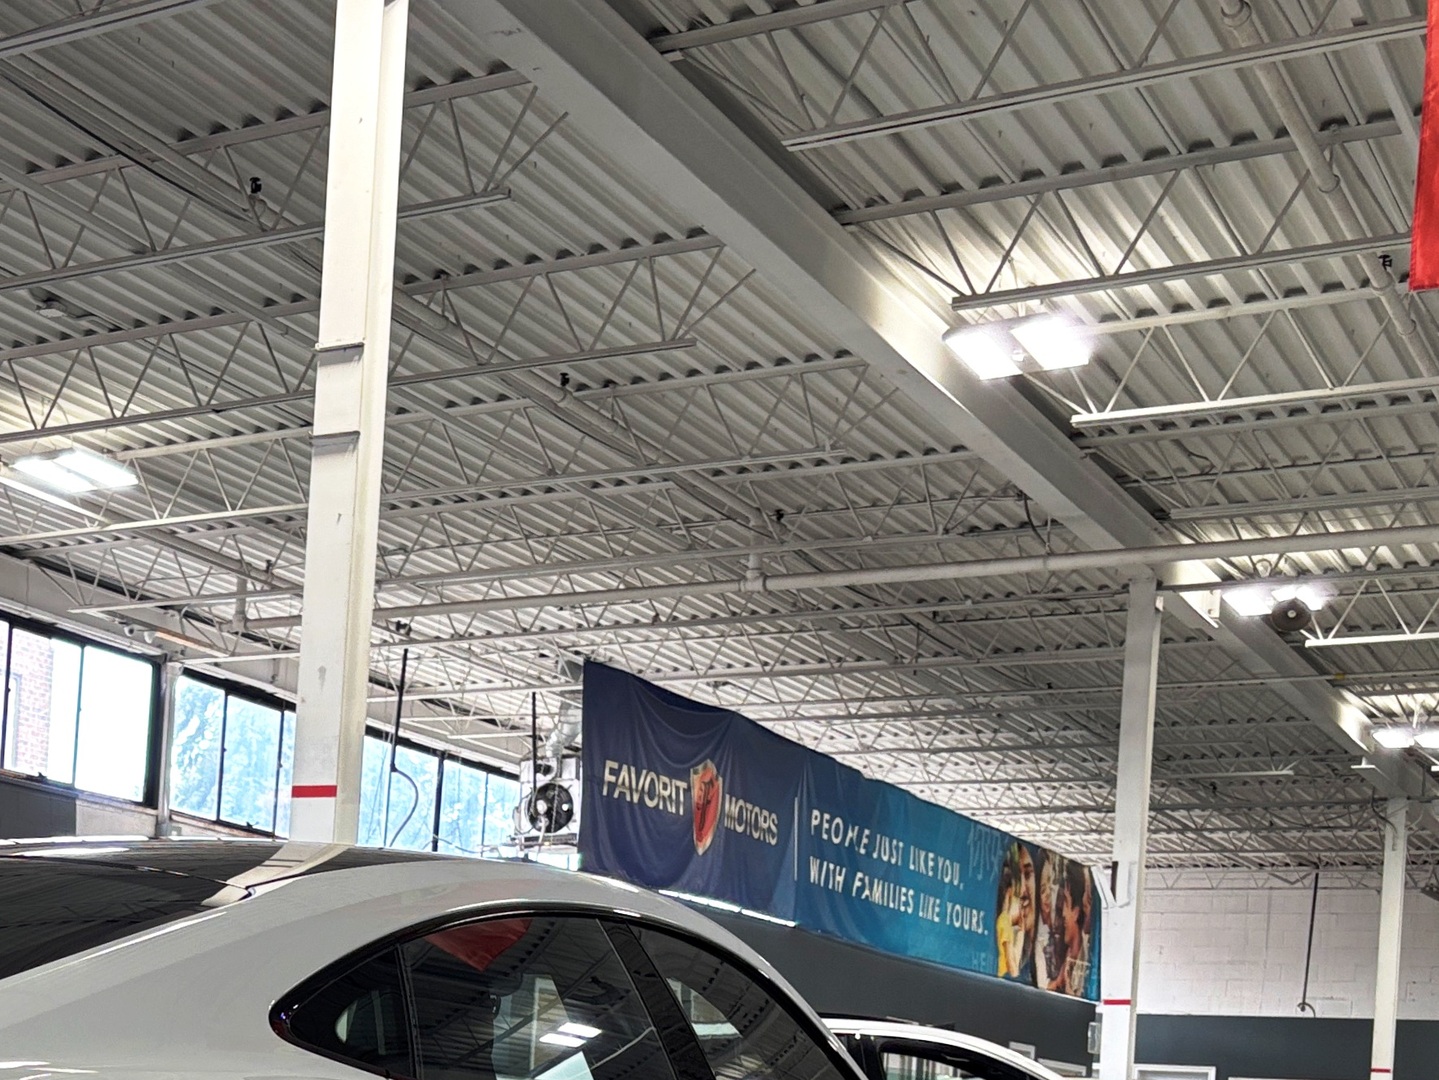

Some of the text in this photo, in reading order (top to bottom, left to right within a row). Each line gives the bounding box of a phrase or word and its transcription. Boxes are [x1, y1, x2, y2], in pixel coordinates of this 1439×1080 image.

[602, 759, 778, 846] FAVORIT MOTORS
[810, 856, 989, 936] WITH FAMILIES LIKE YOURS.
[872, 833, 905, 867] JUST
[909, 845, 935, 878] LIKE
[937, 855, 964, 891] YOU.
